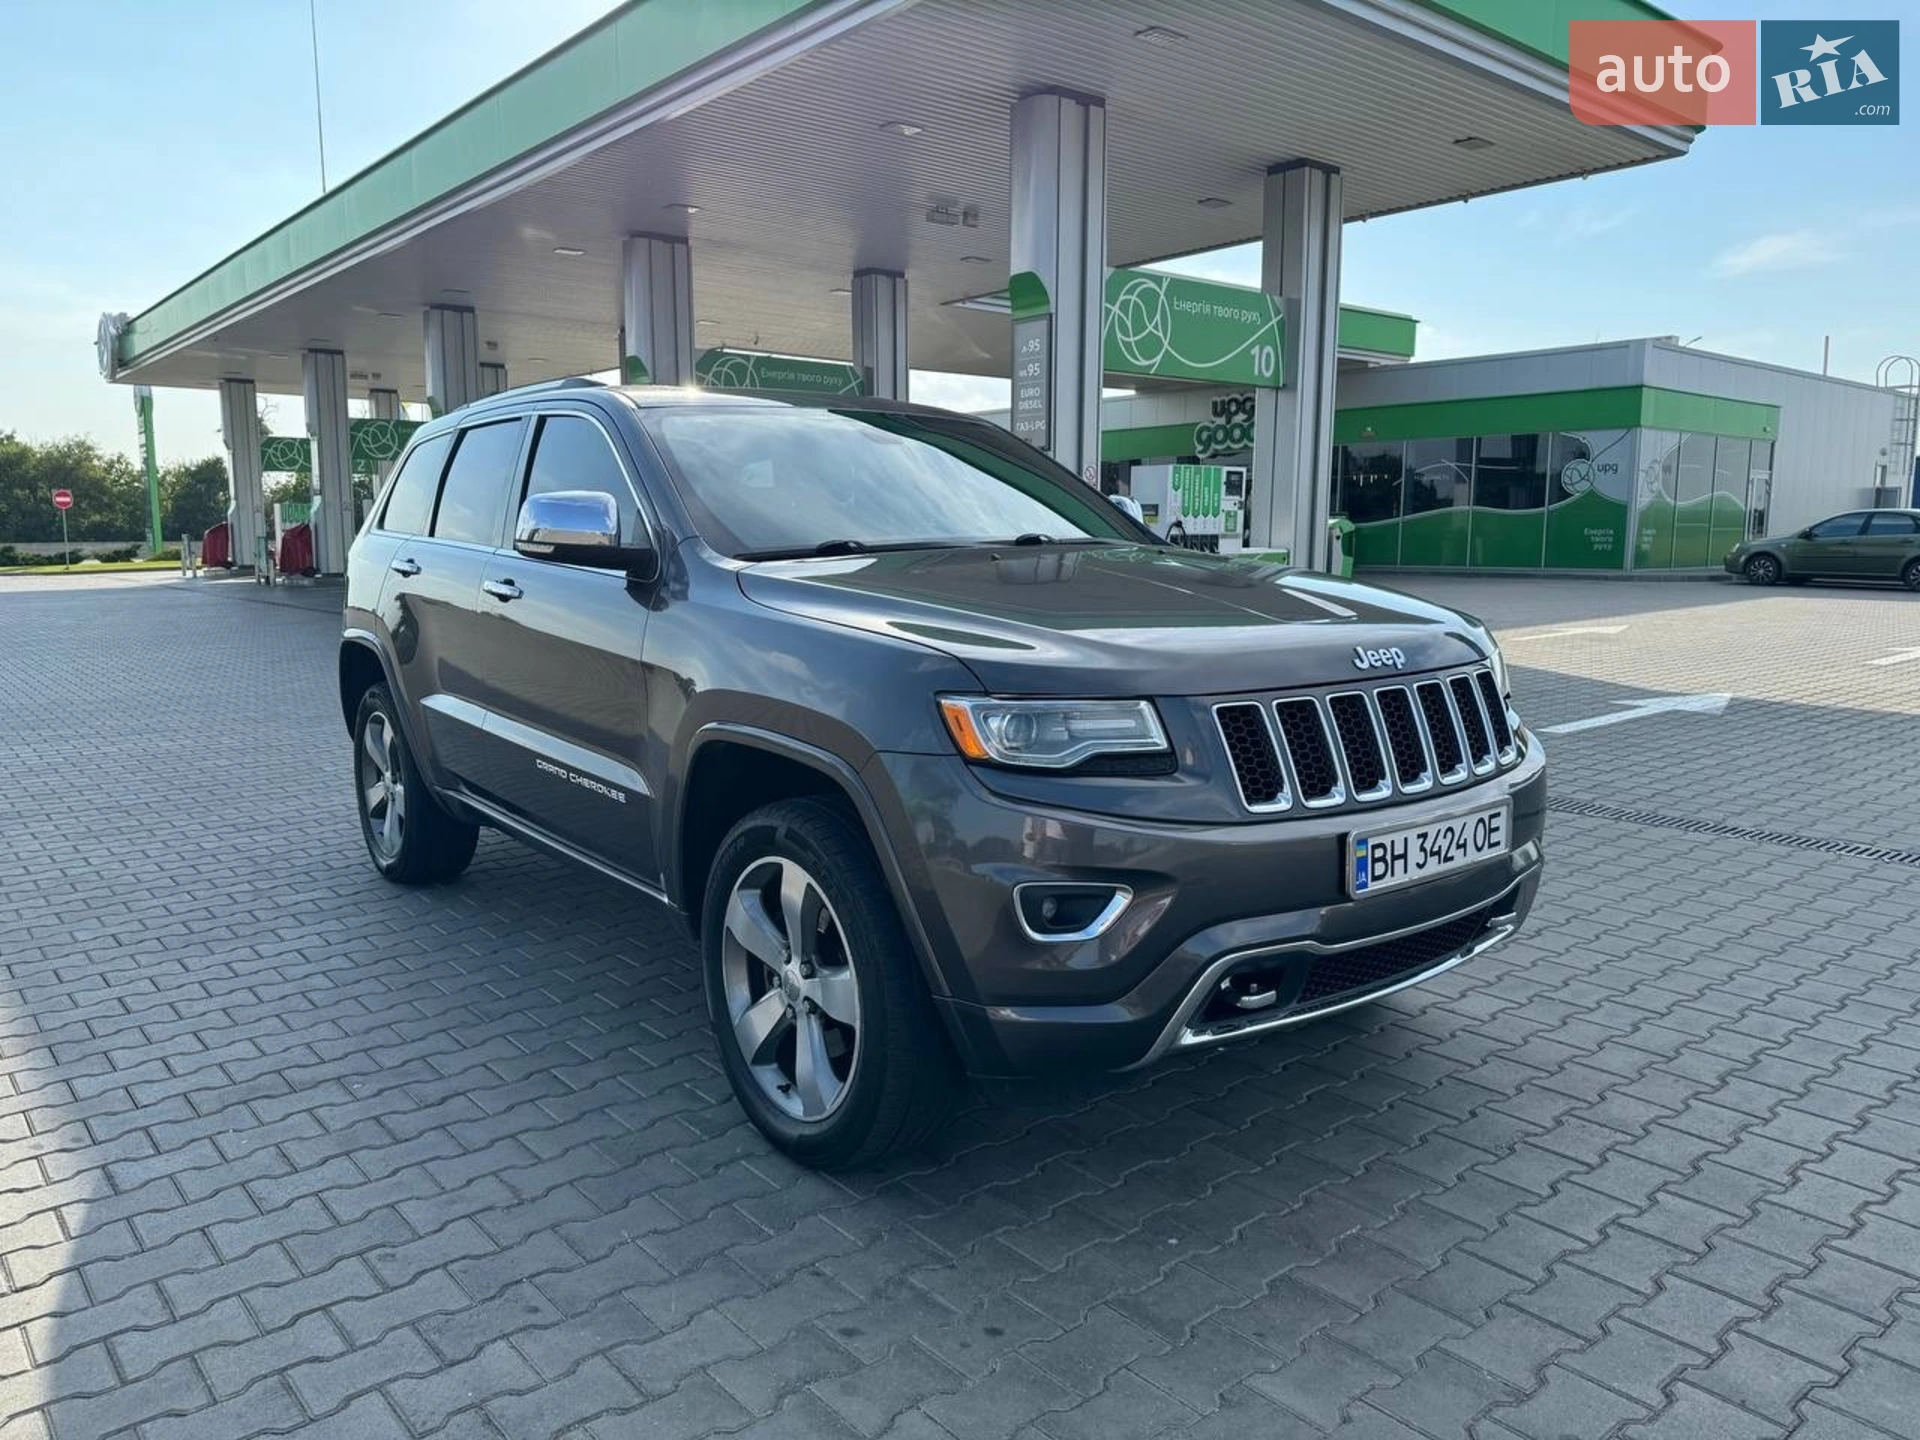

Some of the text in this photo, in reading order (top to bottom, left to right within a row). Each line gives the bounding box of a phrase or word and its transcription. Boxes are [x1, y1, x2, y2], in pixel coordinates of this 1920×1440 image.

[1213, 305, 1240, 319] твого
[1250, 344, 1275, 378] 10
[1020, 387, 1041, 399] EURO
[1211, 396, 1255, 424] upg
[1597, 463, 1618, 474] upg
[1353, 646, 1406, 670] Jeep
[535, 759, 627, 804] GRAND CHEROKEE
[1370, 811, 1501, 883] BH 3424 OE
